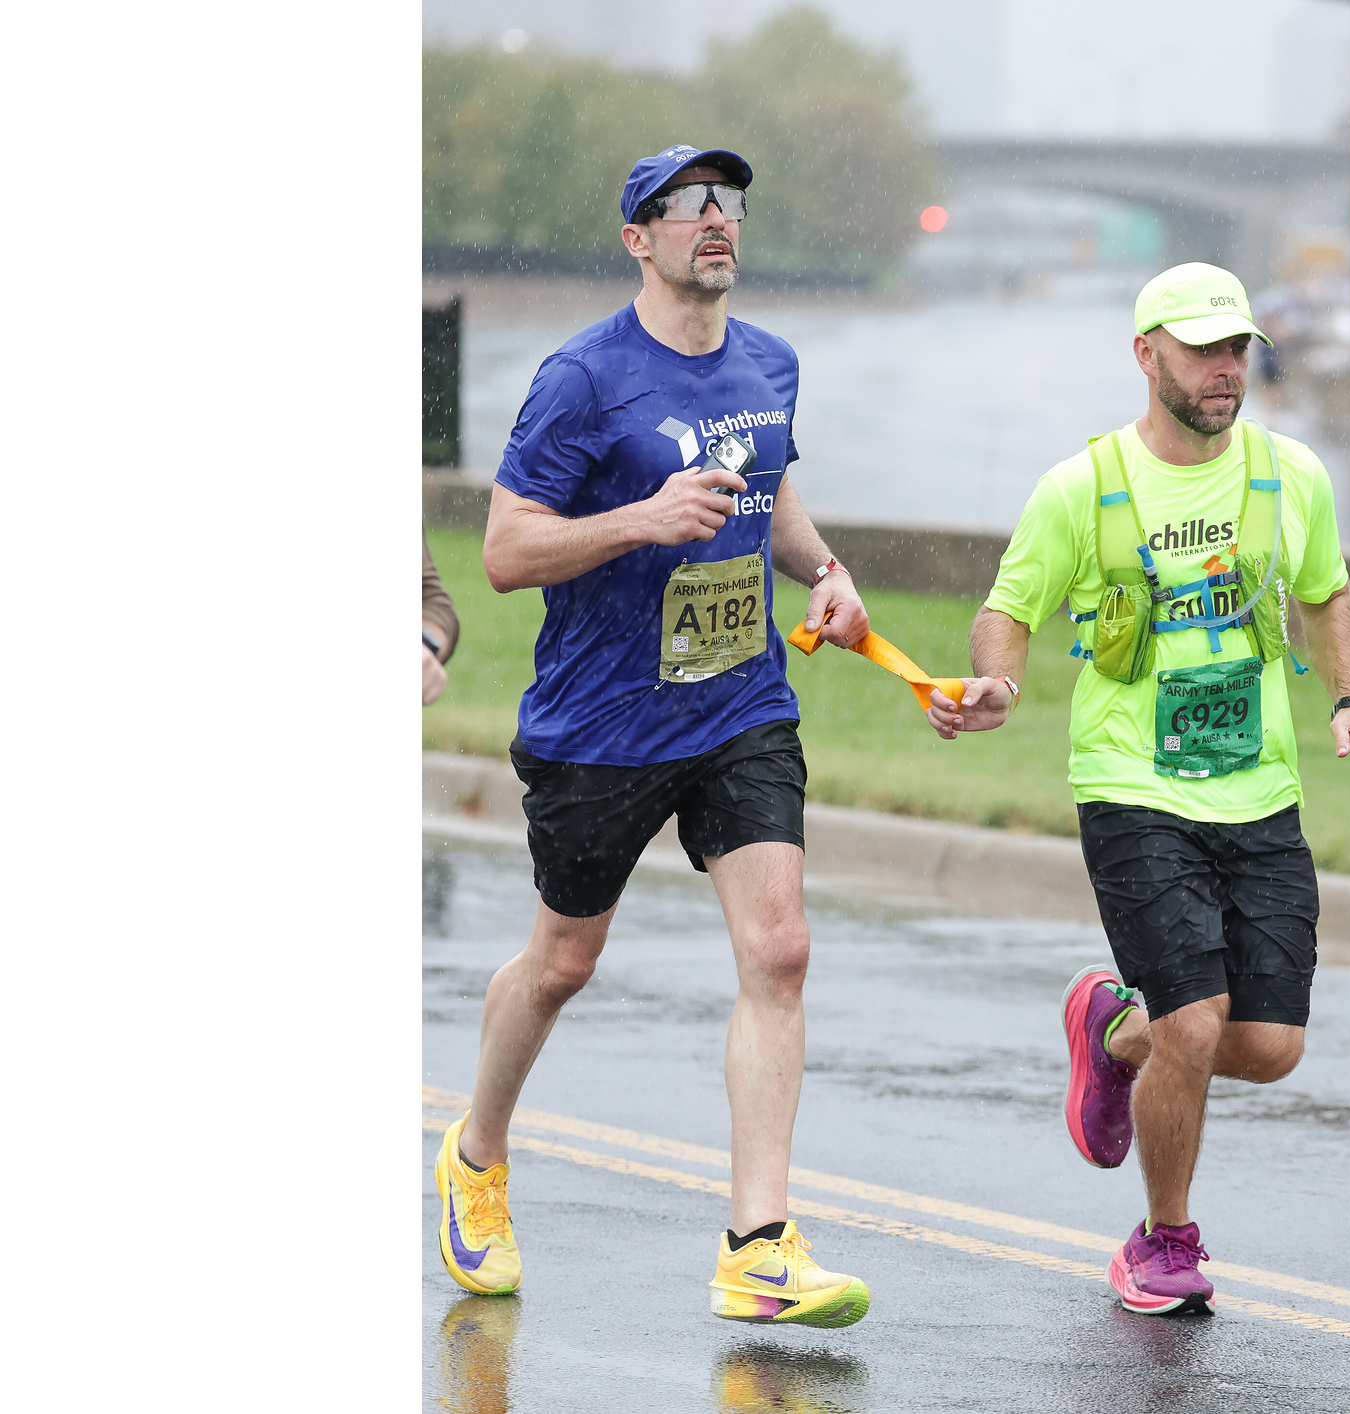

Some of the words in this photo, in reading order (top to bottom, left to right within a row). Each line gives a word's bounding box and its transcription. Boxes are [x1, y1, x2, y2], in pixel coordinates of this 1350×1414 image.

[1210, 296, 1238, 308] GORE
[698, 409, 788, 438] Lighthouse
[1142, 518, 1234, 552] chilles
[1170, 541, 1235, 558] INTERNATIONAL
[673, 584, 710, 596] ARMY
[711, 575, 760, 595] TEN-MILER
[672, 594, 758, 635] A182
[709, 634, 731, 646] AUSA
[1165, 684, 1202, 698] ARMY
[1203, 675, 1256, 696] TEN-MILER
[1171, 697, 1250, 735] 6929
[1201, 732, 1222, 745] AUSA
